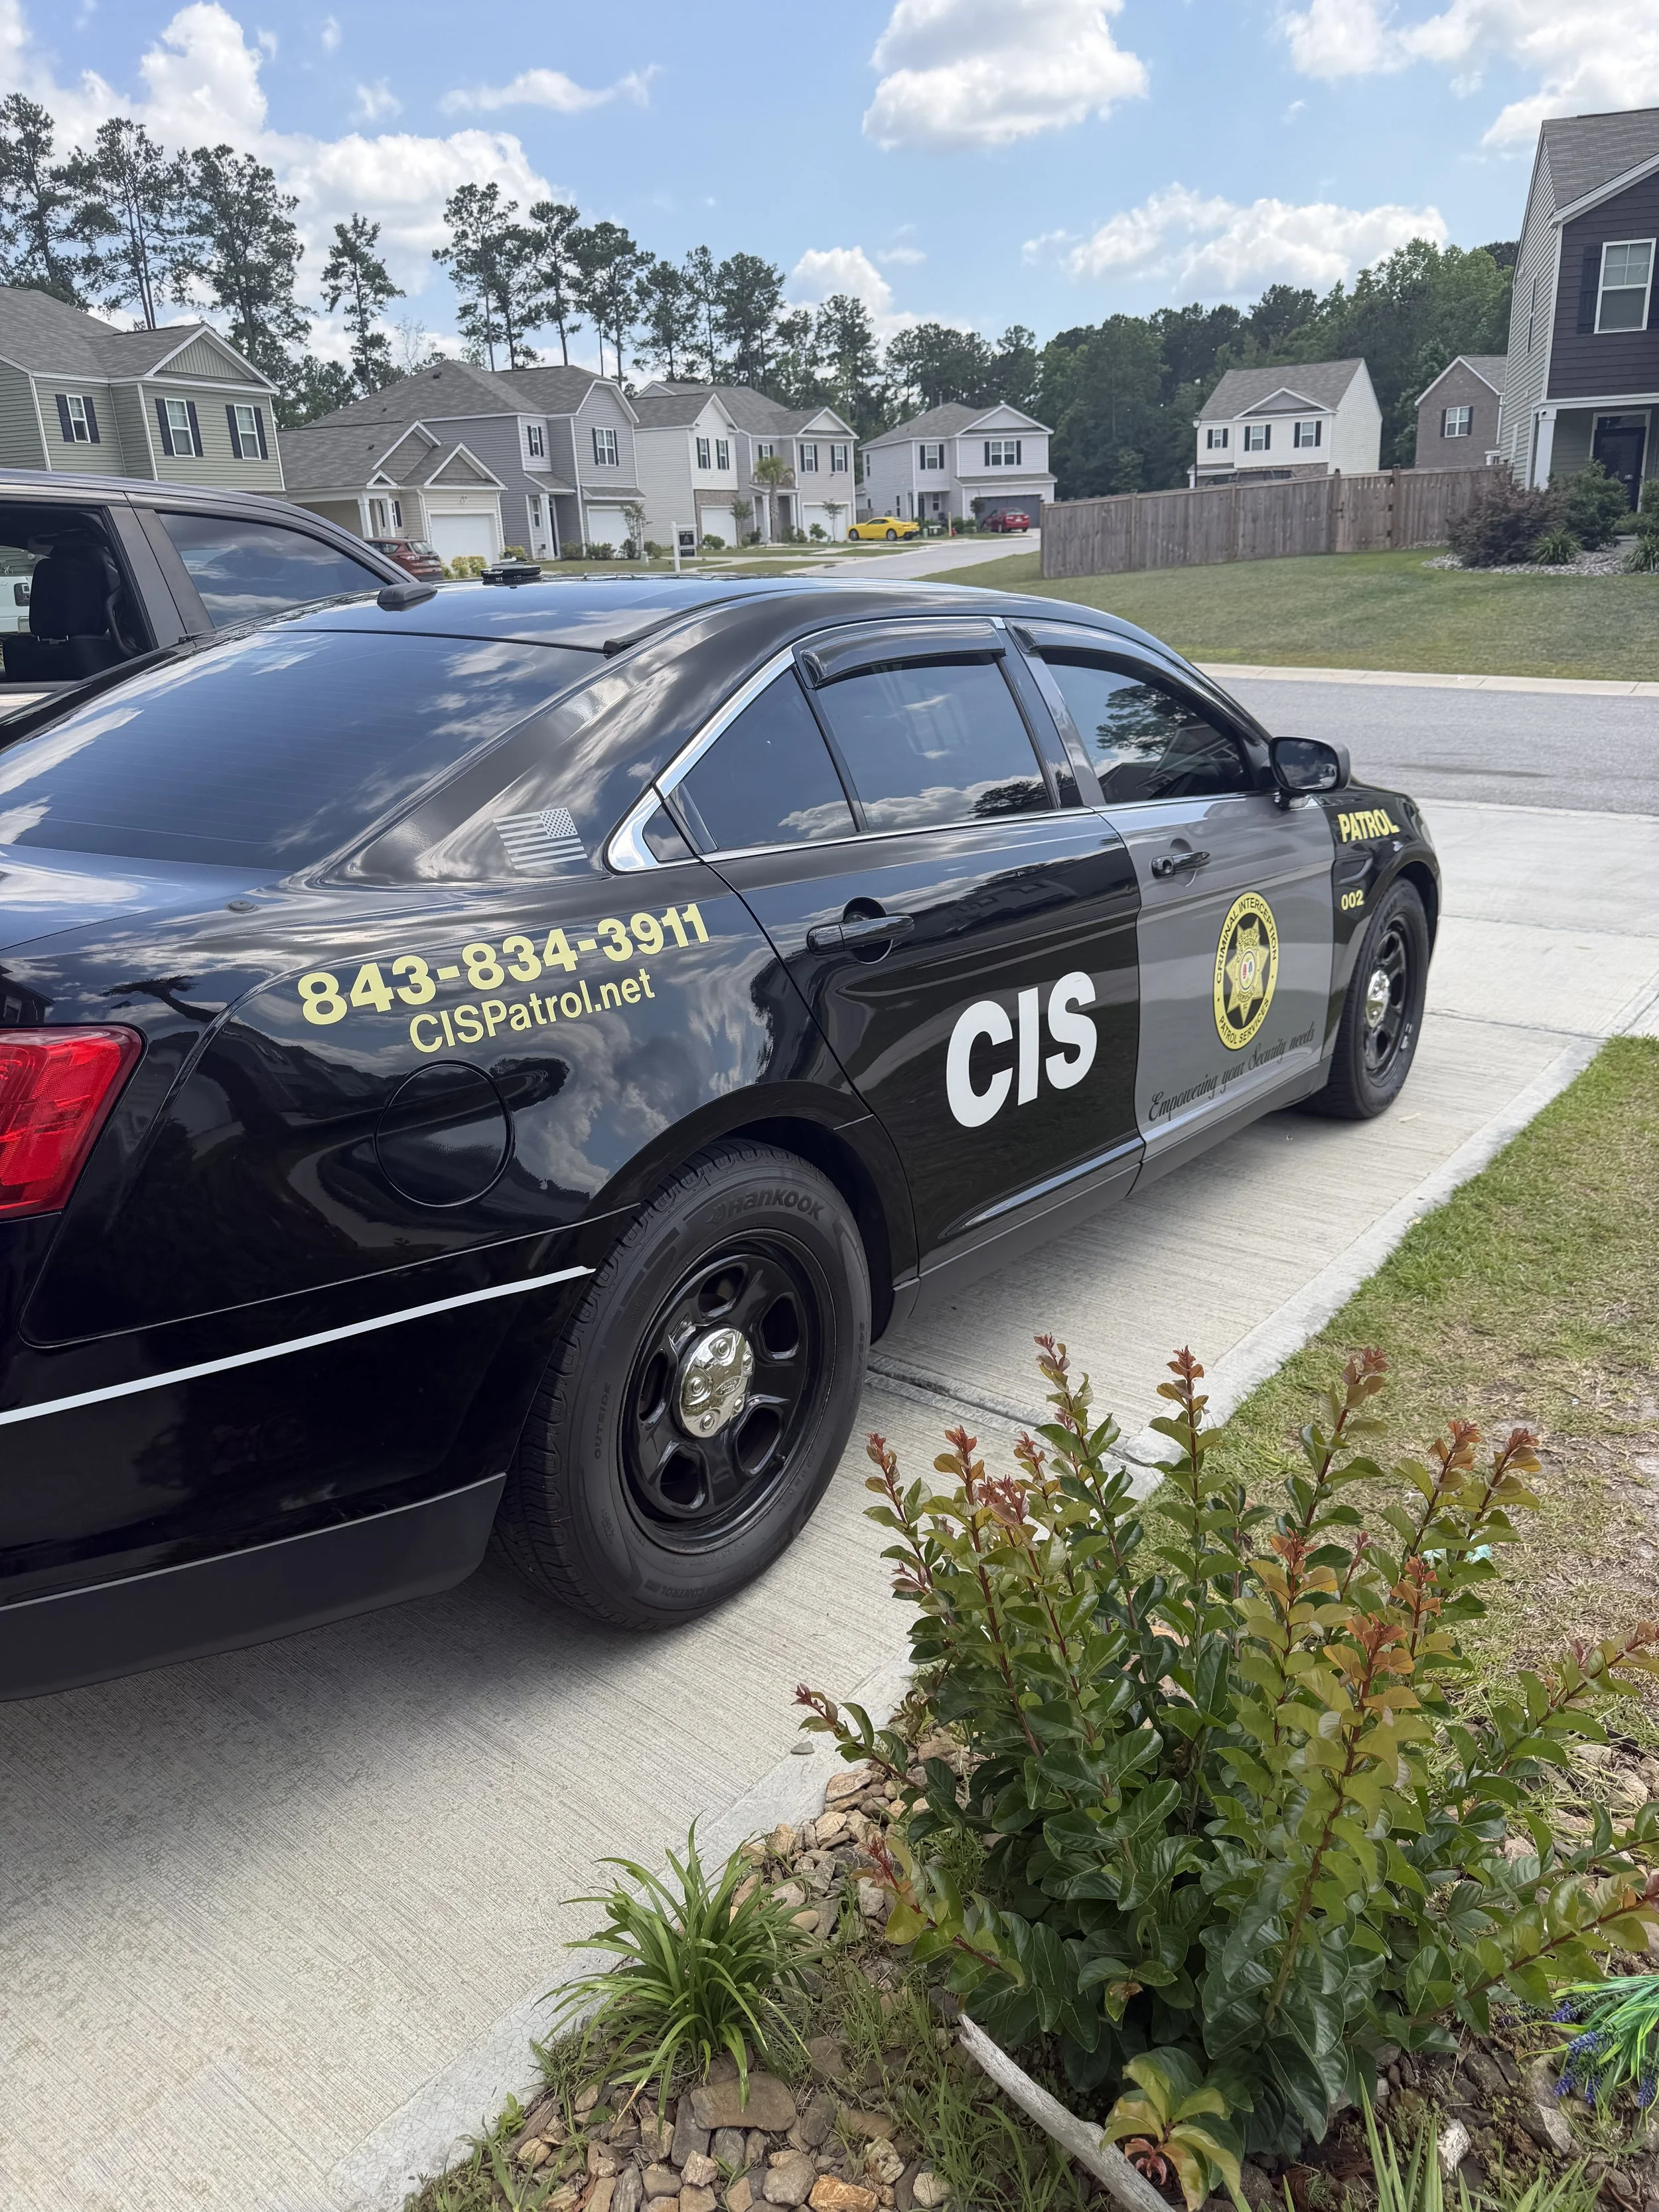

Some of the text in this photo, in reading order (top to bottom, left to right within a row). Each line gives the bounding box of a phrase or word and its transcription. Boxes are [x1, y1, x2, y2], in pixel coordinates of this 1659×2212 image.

[1337, 808, 1400, 843] PATROL
[1216, 897, 1277, 984] CRIMINAL INTERCEPTION
[1340, 889, 1364, 911] 002
[297, 903, 710, 1026] 843-834-3911
[409, 967, 656, 1053] CISPatrol.net
[946, 972, 1097, 1128] CIS
[1218, 998, 1269, 1045] PATROL SERVICES
[1149, 1021, 1315, 1122] Empowering your Security needs
[595, 1382, 612, 1460] OUTSIDE
